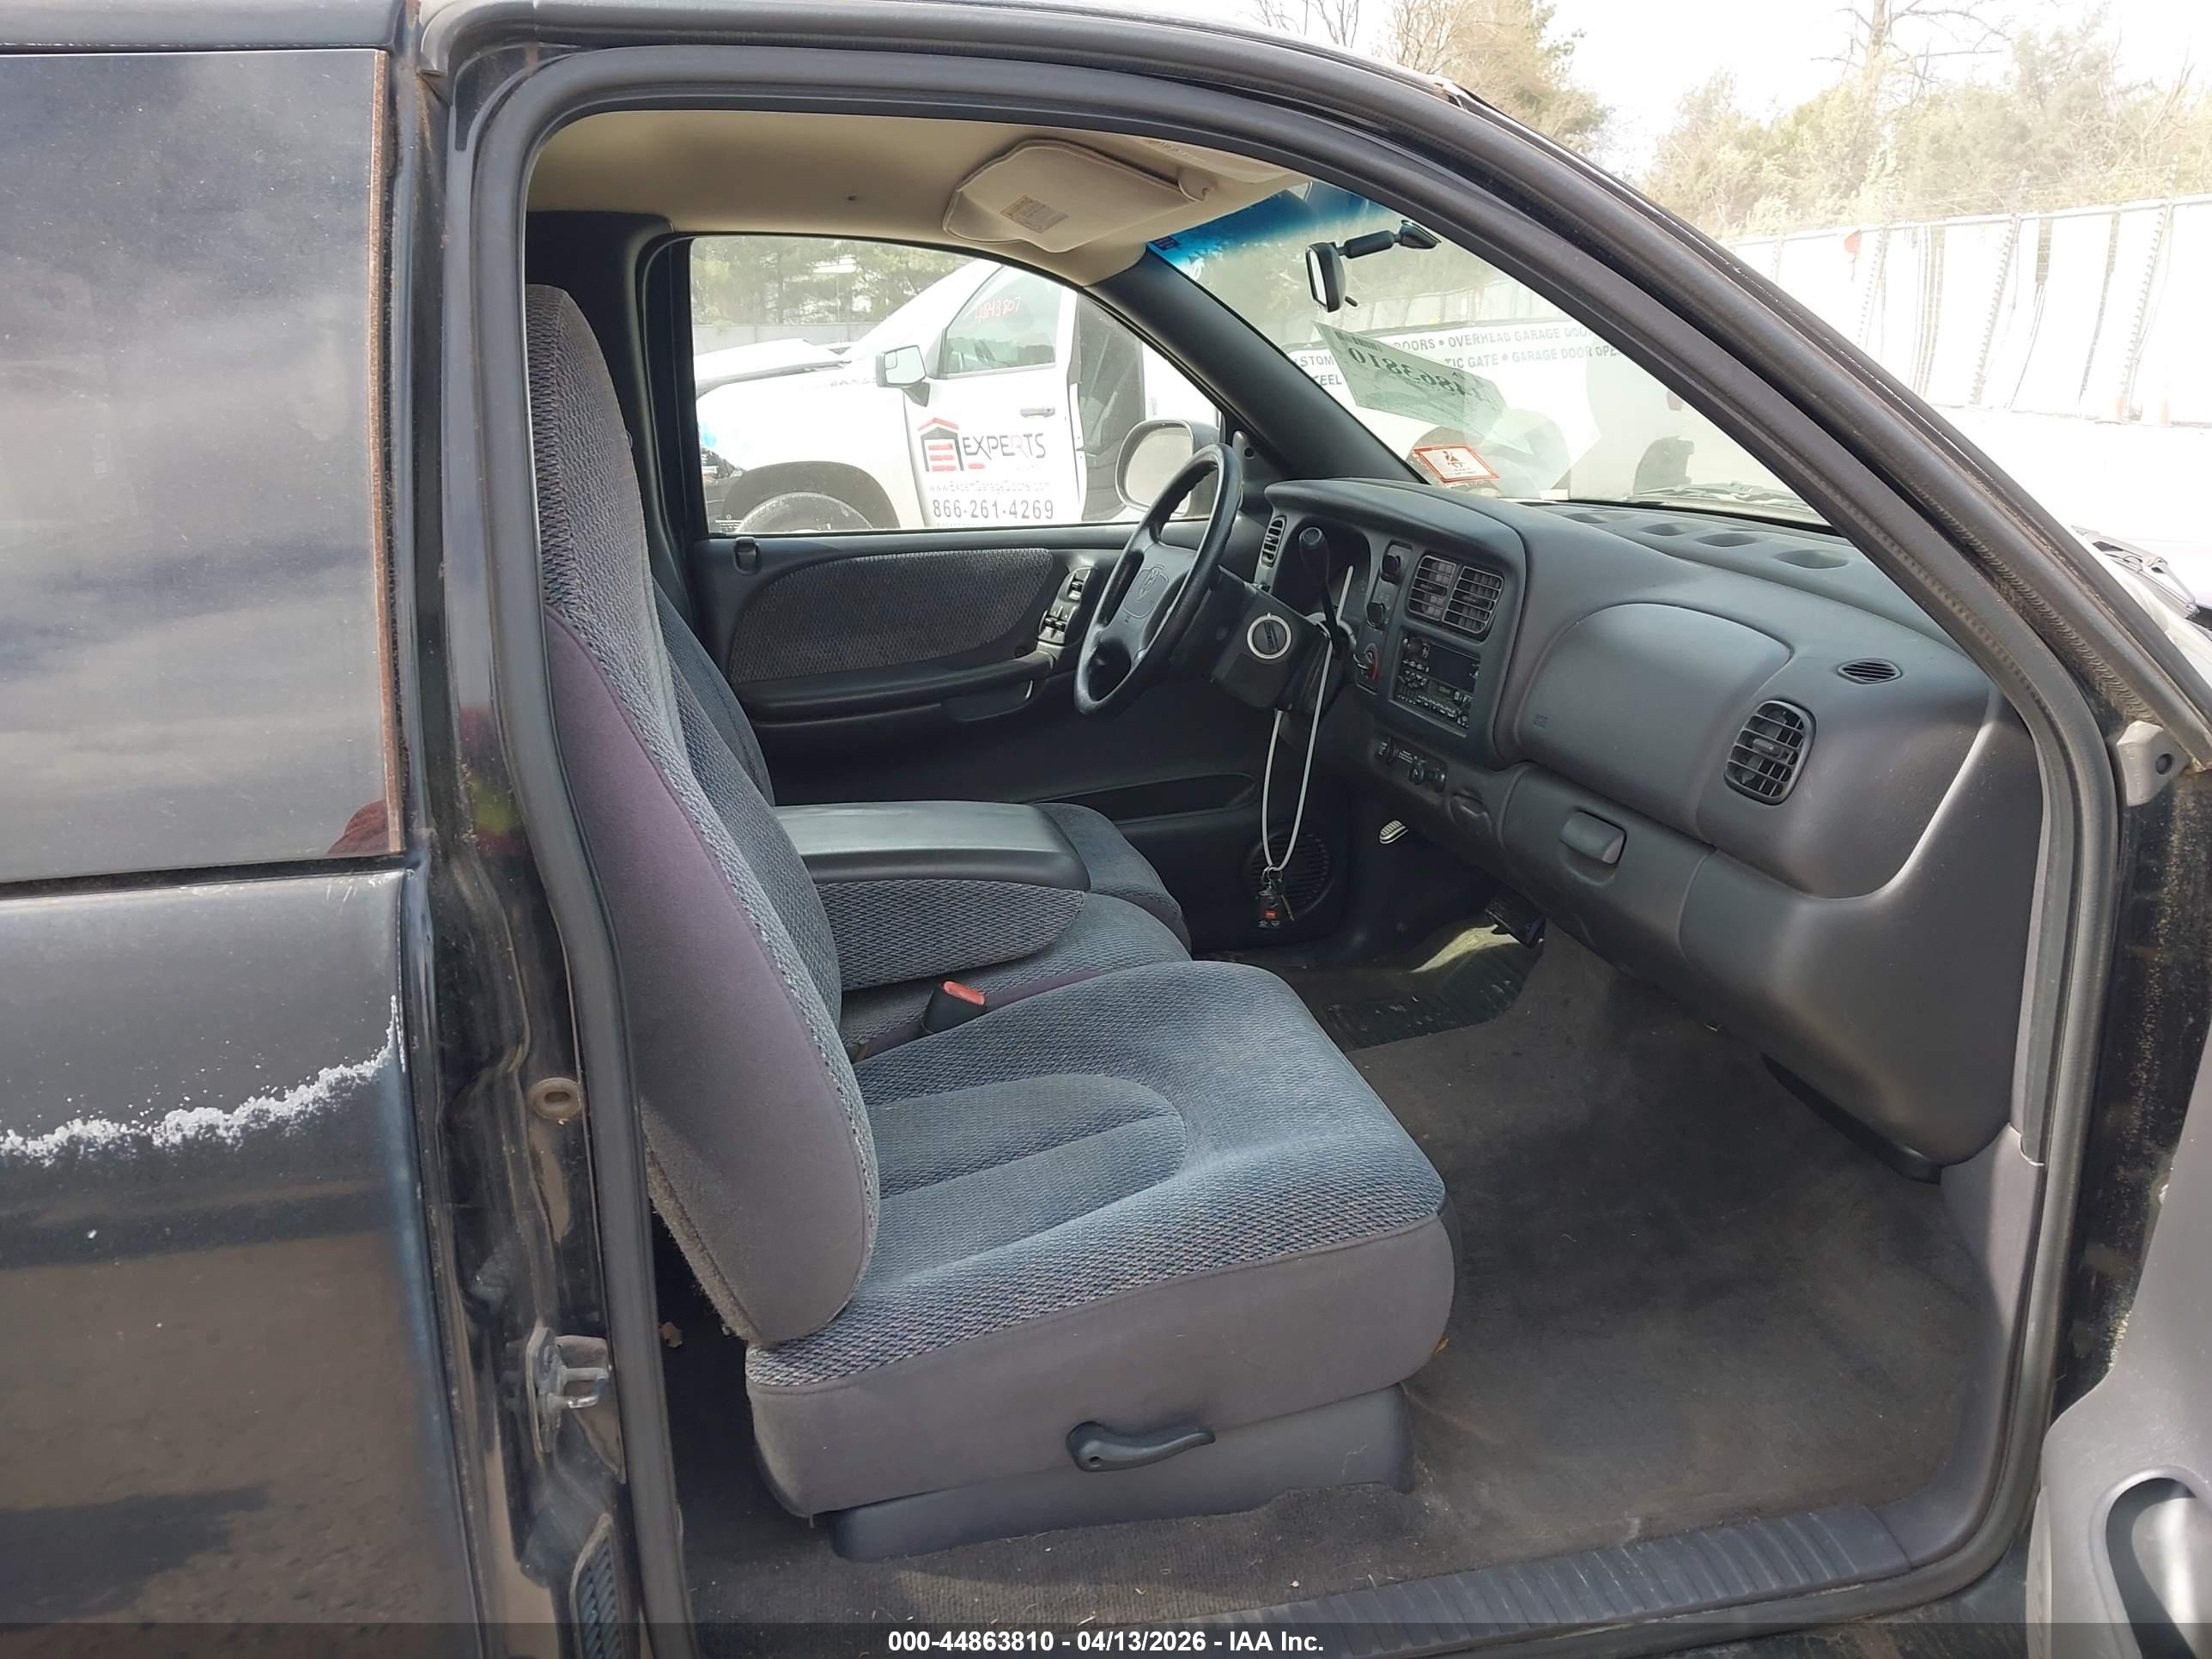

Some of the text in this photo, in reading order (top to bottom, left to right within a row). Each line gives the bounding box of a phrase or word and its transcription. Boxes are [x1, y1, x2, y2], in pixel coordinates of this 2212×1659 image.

[1294, 355, 1335, 368] STOM
[1448, 332, 1511, 348] OVERHEAD
[1514, 328, 1560, 342] GARAGE
[1564, 326, 1592, 337] DOO
[1468, 353, 1499, 368] GATE
[1511, 348, 1559, 362] GARAGE
[1560, 345, 1593, 360] DOOR
[1595, 344, 1620, 357] OPE
[962, 432, 1046, 460] EXPERTS
